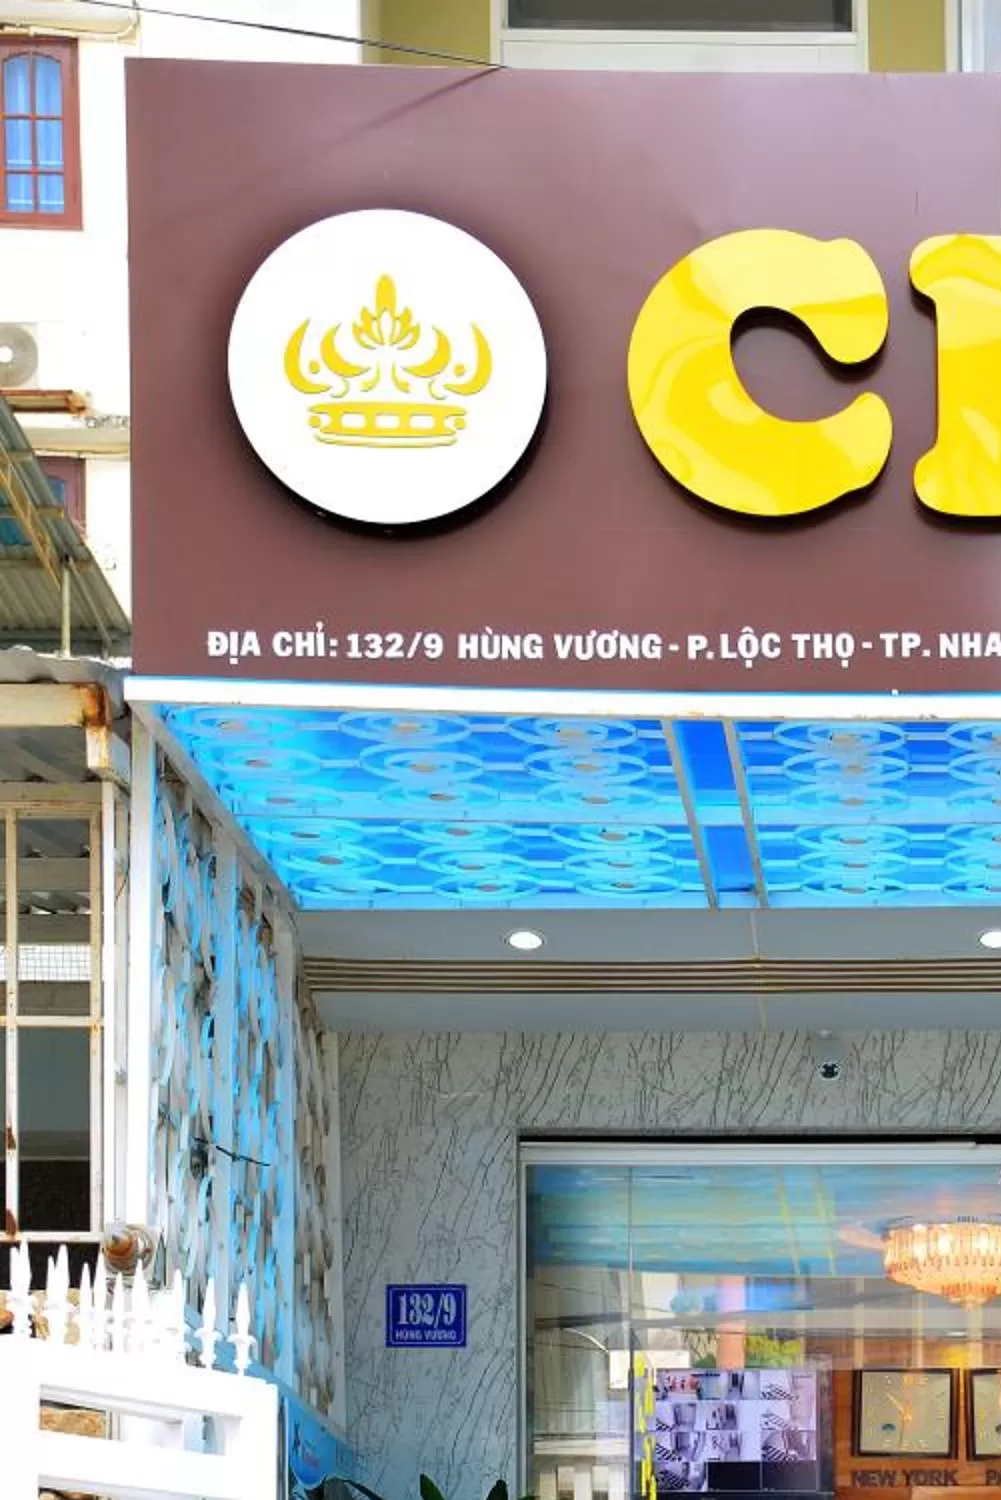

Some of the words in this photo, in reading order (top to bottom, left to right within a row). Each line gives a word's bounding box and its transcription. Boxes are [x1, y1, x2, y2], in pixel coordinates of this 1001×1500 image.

[207, 631, 261, 665] ĐỊA
[345, 633, 443, 659] 132/9
[457, 626, 543, 660] HÙNG
[553, 629, 663, 660] VƯƠNG
[791, 632, 855, 668] THỌ
[852, 1469, 897, 1486] NEW
[903, 1469, 959, 1486] YORK
